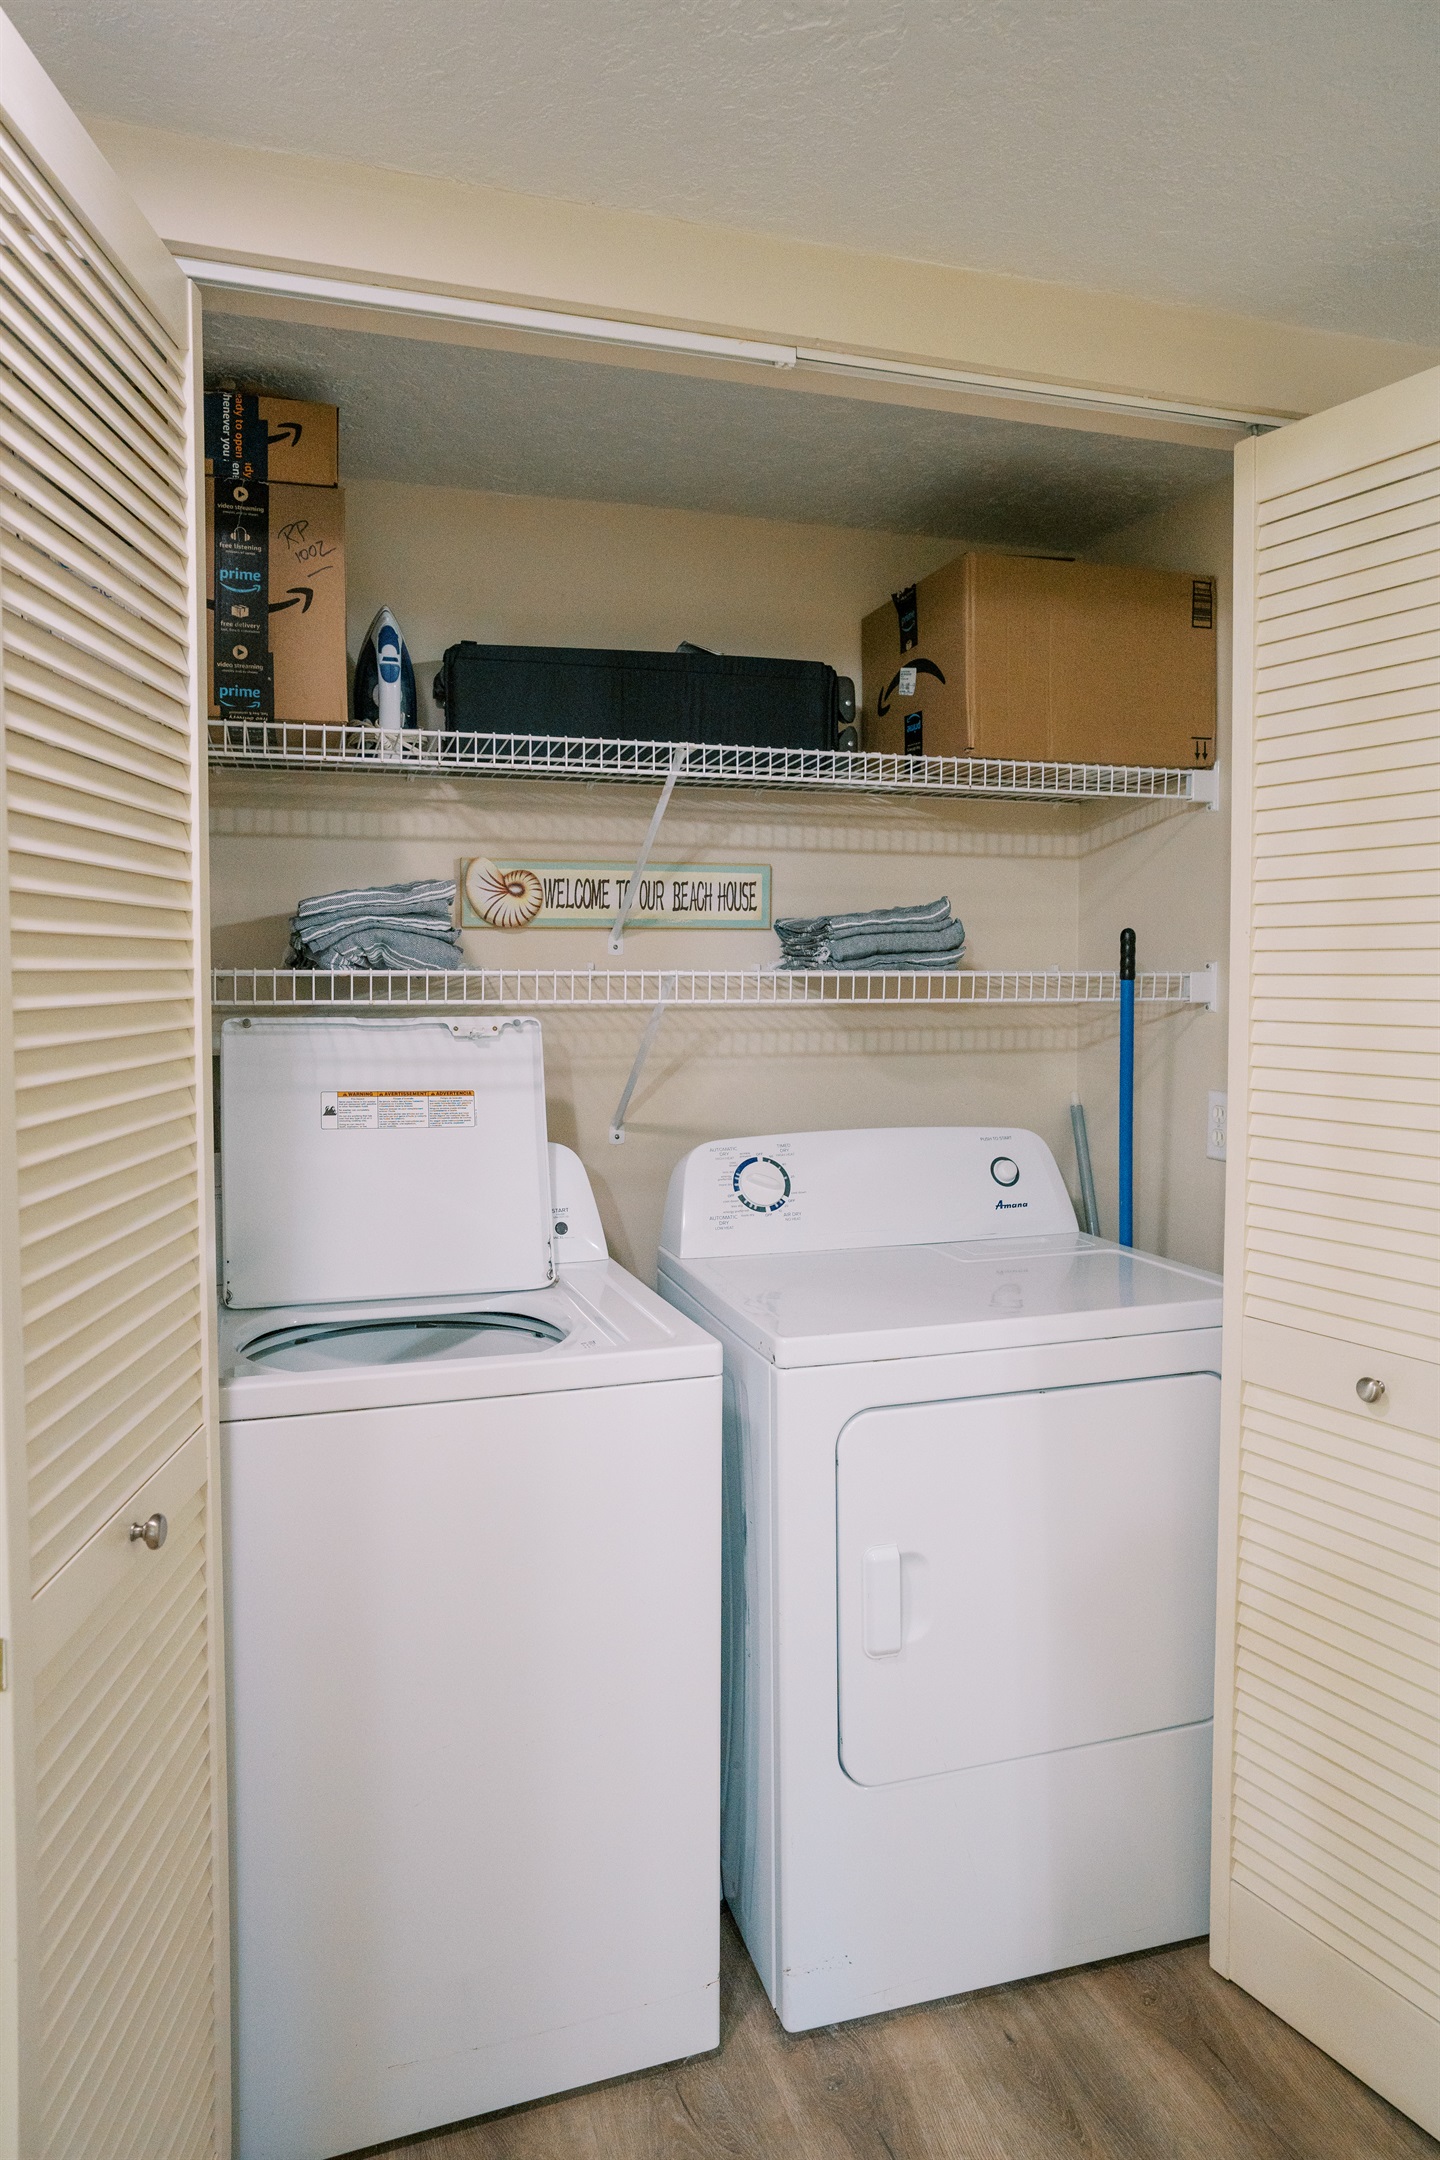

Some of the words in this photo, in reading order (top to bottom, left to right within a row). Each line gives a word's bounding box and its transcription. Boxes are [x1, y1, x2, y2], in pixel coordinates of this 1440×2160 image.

[235, 420, 244, 430] to
[220, 438, 230, 456] you
[233, 432, 242, 458] open
[234, 504, 264, 514] streaming
[234, 542, 262, 552] listening
[220, 567, 261, 581] prime
[234, 622, 260, 630] delivery
[234, 664, 264, 672] streaming
[220, 684, 260, 698] prime
[543, 878, 610, 910] WELCOME
[639, 880, 664, 910] OUR
[672, 880, 712, 912] BEACH
[717, 880, 758, 912] HOUSE
[995, 1200, 1028, 1210] Amana
